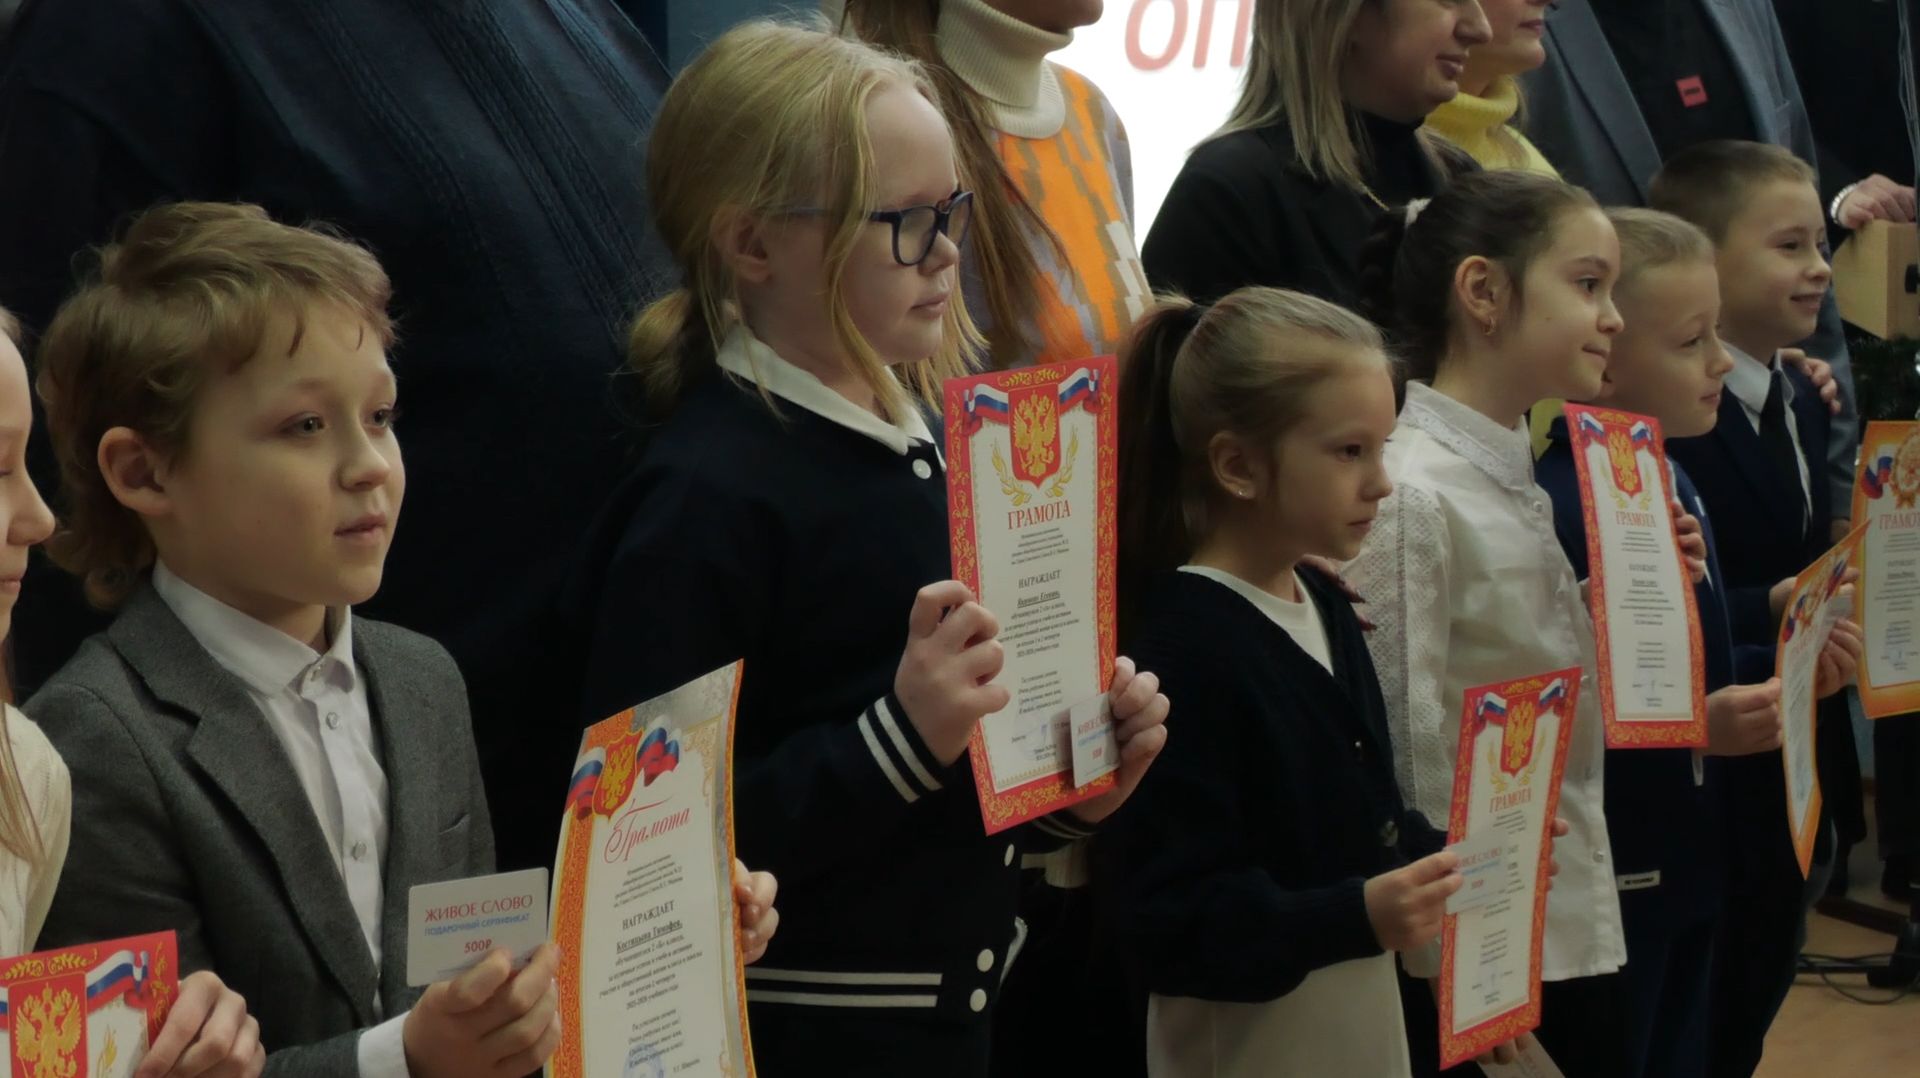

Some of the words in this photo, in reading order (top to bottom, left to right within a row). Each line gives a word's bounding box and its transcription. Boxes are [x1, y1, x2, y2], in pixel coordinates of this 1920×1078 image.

[1008, 499, 1071, 530] ГРАМОТА
[1615, 511, 1657, 528] ГРАМОТА
[1018, 569, 1062, 589] НАГРАЖДАЕТ
[1489, 787, 1531, 813] ГРАМОТА
[604, 797, 690, 864] Грамота
[425, 902, 477, 922] ЖИВОЕ
[481, 894, 533, 914] СЛОВО
[622, 900, 675, 930] НАГРАЖДАЕТ
[425, 919, 480, 936] ПОДАРОЧНЫЙ
[481, 913, 530, 928] СЕРТИФИКАТ
